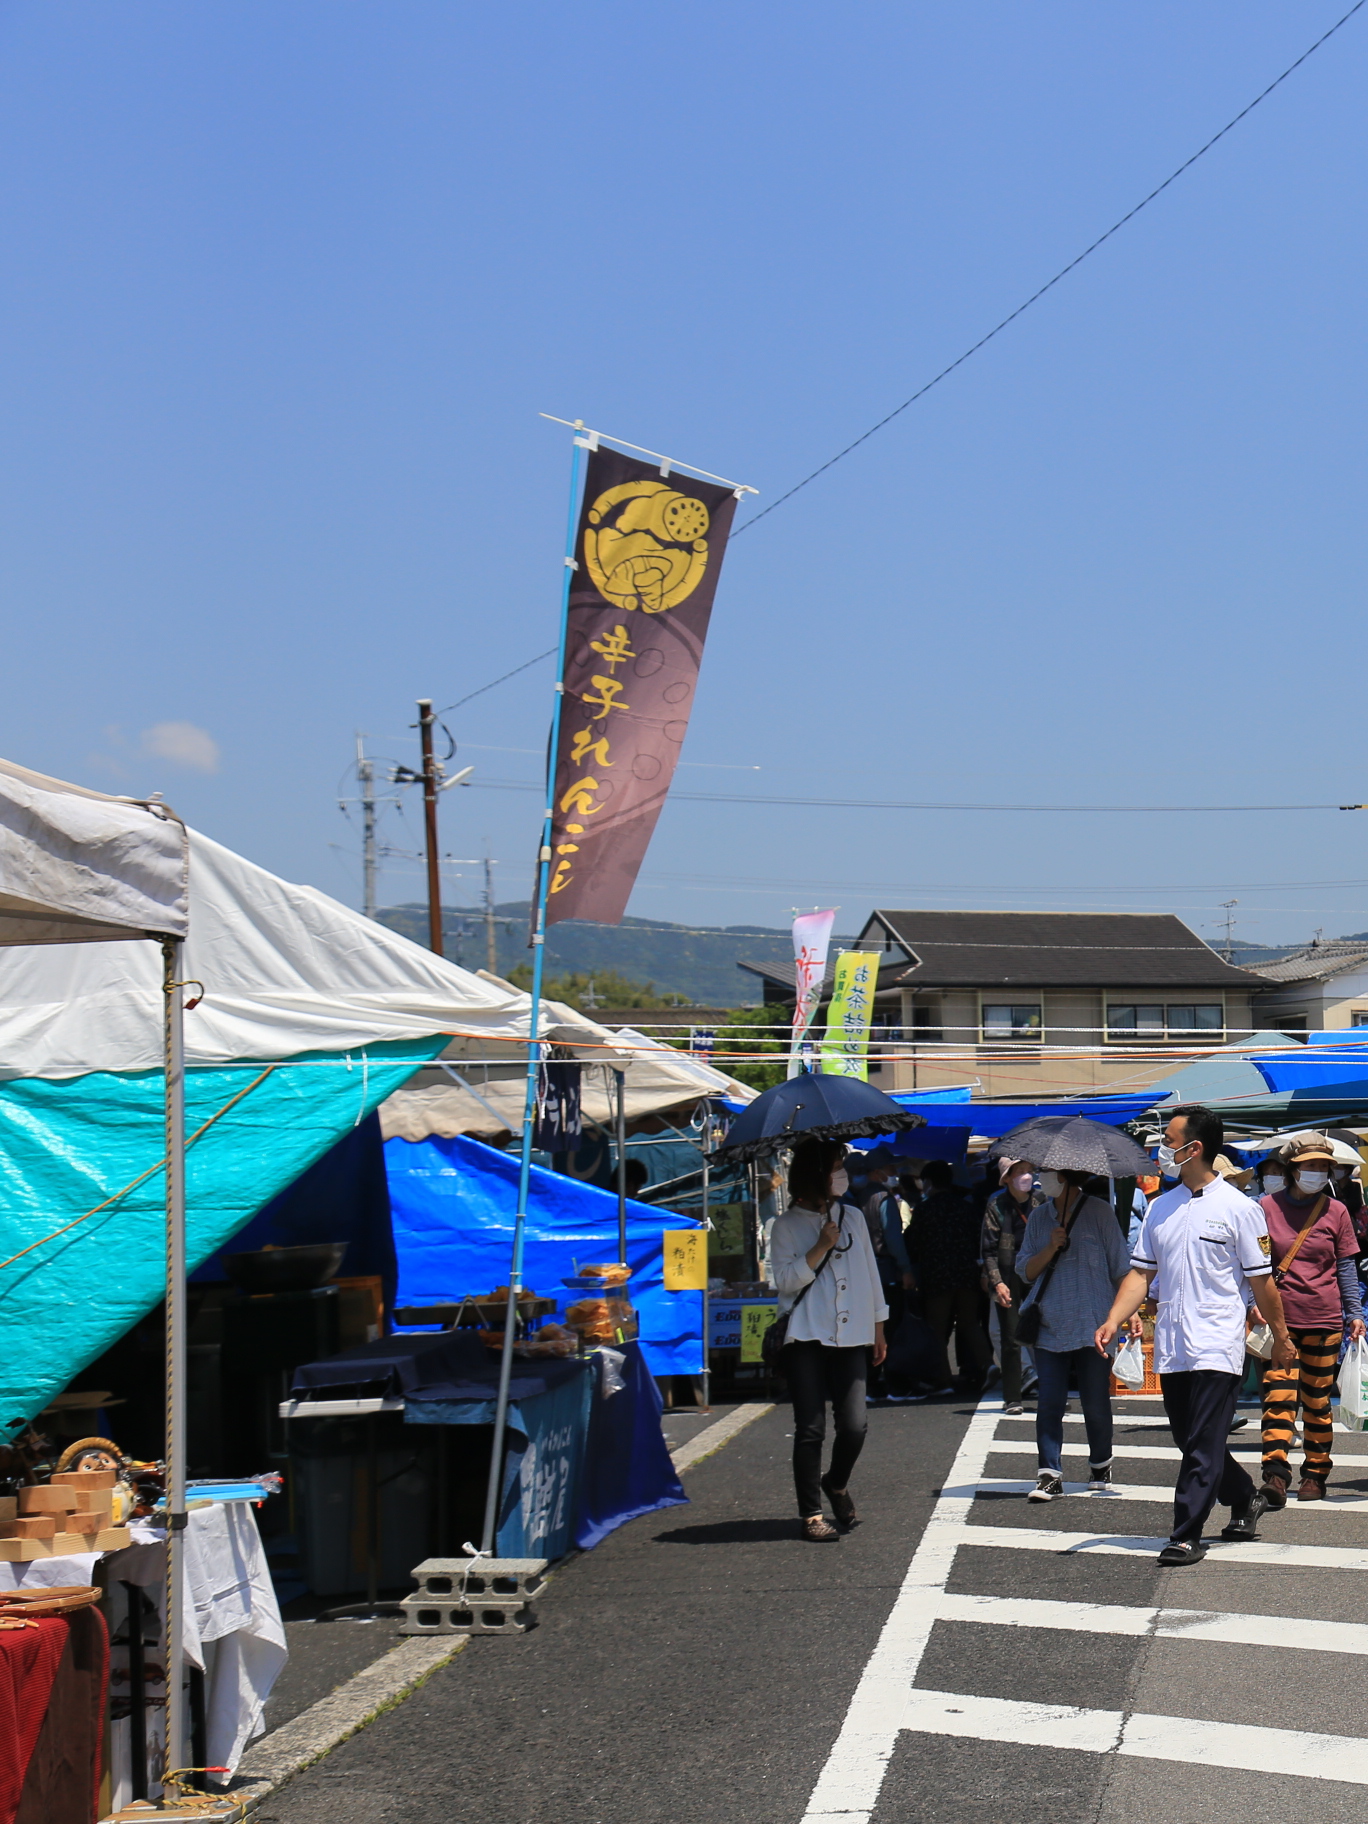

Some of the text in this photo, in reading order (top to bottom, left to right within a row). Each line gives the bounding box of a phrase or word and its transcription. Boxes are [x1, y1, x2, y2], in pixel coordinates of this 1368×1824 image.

[546, 624, 637, 902] 辛子れんこん
